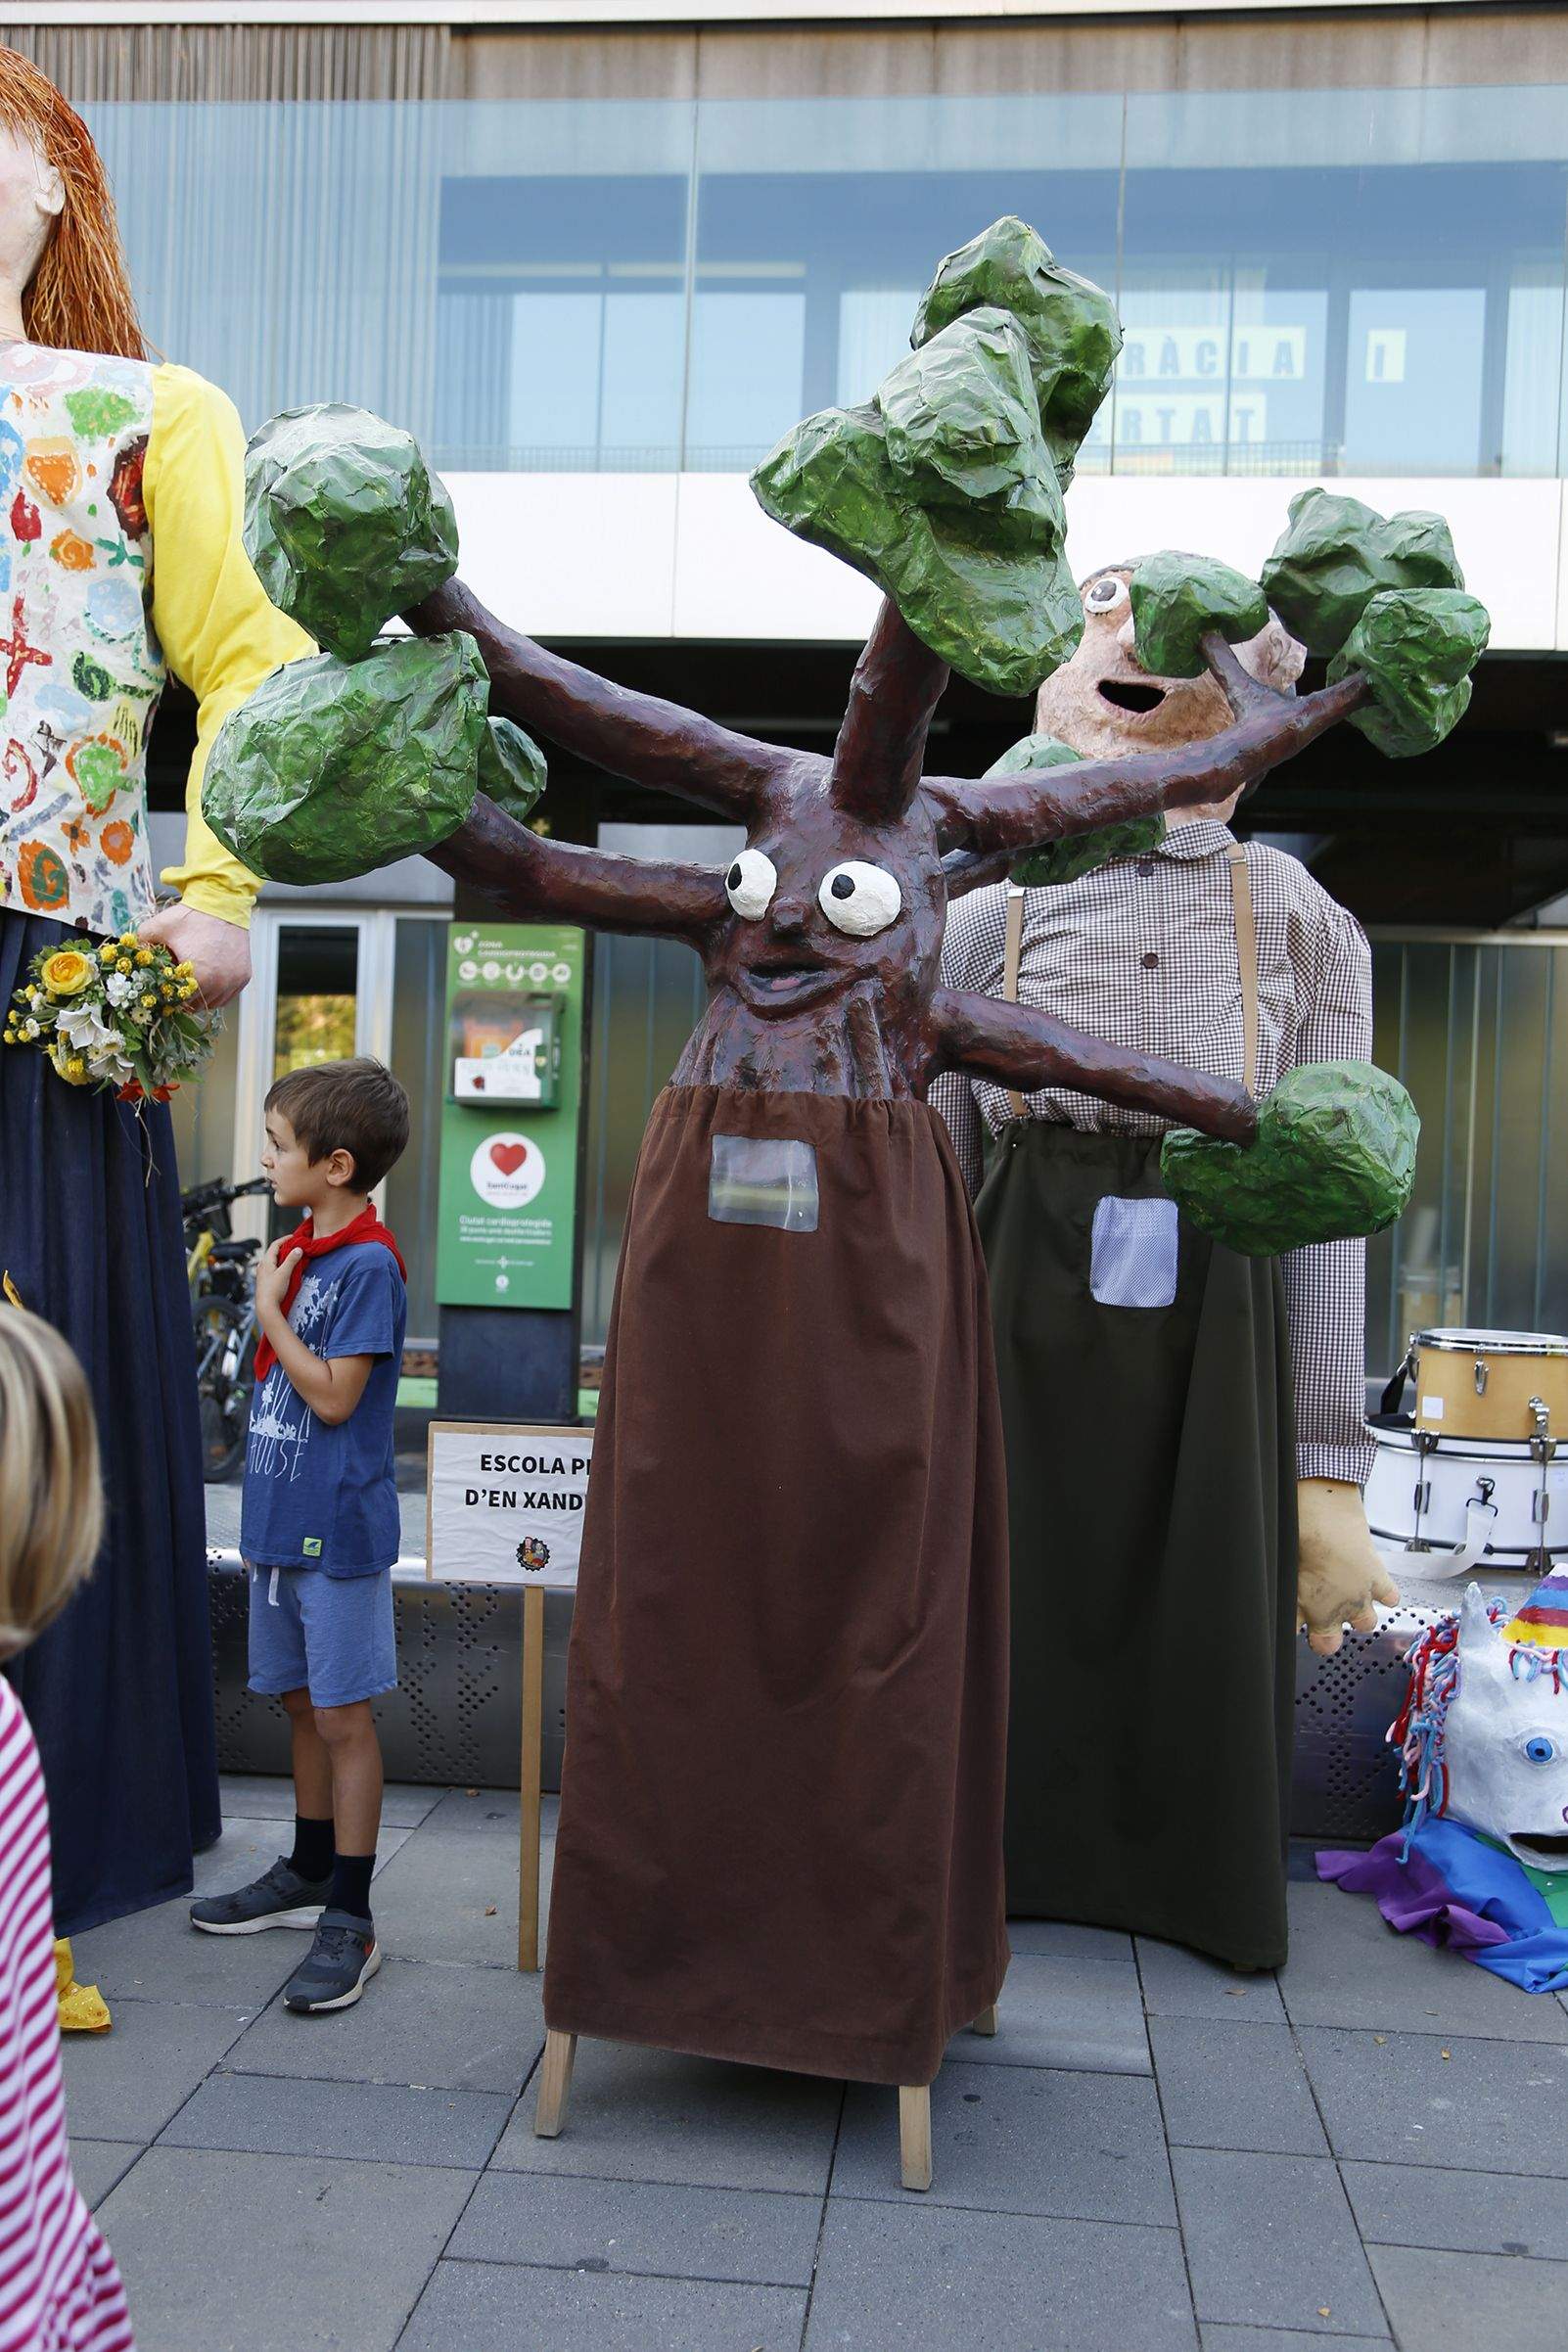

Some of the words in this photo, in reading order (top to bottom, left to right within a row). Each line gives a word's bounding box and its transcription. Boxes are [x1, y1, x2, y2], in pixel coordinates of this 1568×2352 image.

[1125, 336, 1294, 376] RÀCIA
[480, 1453, 566, 1475] ESCOLA
[523, 1491, 584, 1511] XAND
